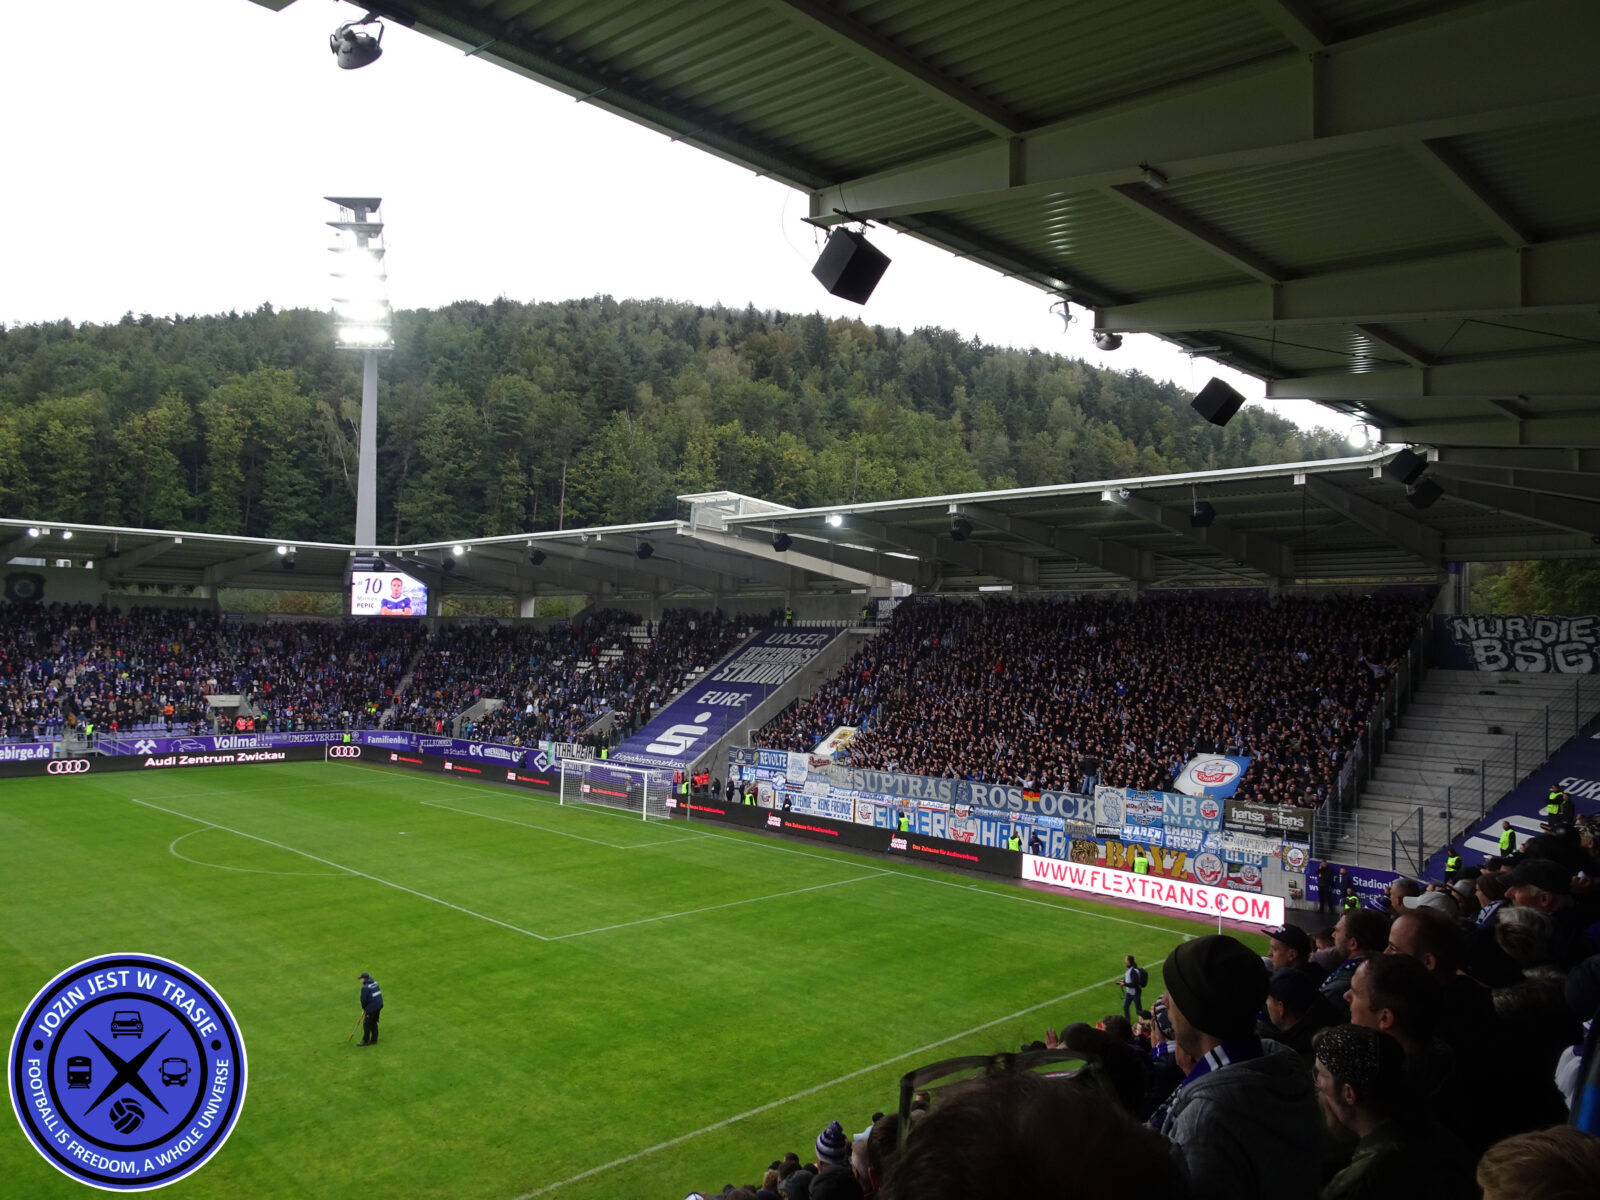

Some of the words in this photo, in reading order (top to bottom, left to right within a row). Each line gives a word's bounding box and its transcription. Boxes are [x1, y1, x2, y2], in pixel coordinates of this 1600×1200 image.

[764, 633, 828, 645] UNSER
[1454, 617, 1528, 640] NUR
[1534, 618, 1596, 644] DIE
[1472, 638, 1594, 673] BSG
[711, 662, 802, 685] STADION
[696, 690, 752, 707] EURE
[213, 736, 272, 748] Vollma
[469, 744, 484, 757] GK
[0, 744, 50, 760] ebirge.de
[144, 756, 176, 767] Audi
[178, 754, 234, 765] Zentrum
[236, 752, 286, 762] Zwickau
[760, 752, 787, 767] REVOLTE
[852, 769, 952, 803] SUPTRAS
[1548, 777, 1600, 800] EUR
[1162, 794, 1197, 816] NB
[1162, 815, 1181, 825] ON
[1184, 817, 1220, 830] TOUR
[1232, 808, 1264, 822] hansa
[1278, 812, 1304, 828] fans
[1124, 826, 1162, 840] WAREN
[1164, 826, 1203, 840] CHAOS
[1166, 835, 1201, 852] CREW
[1104, 840, 1188, 880] BOYZ
[1034, 860, 1270, 920] WWW.FLEXTRANS.COM
